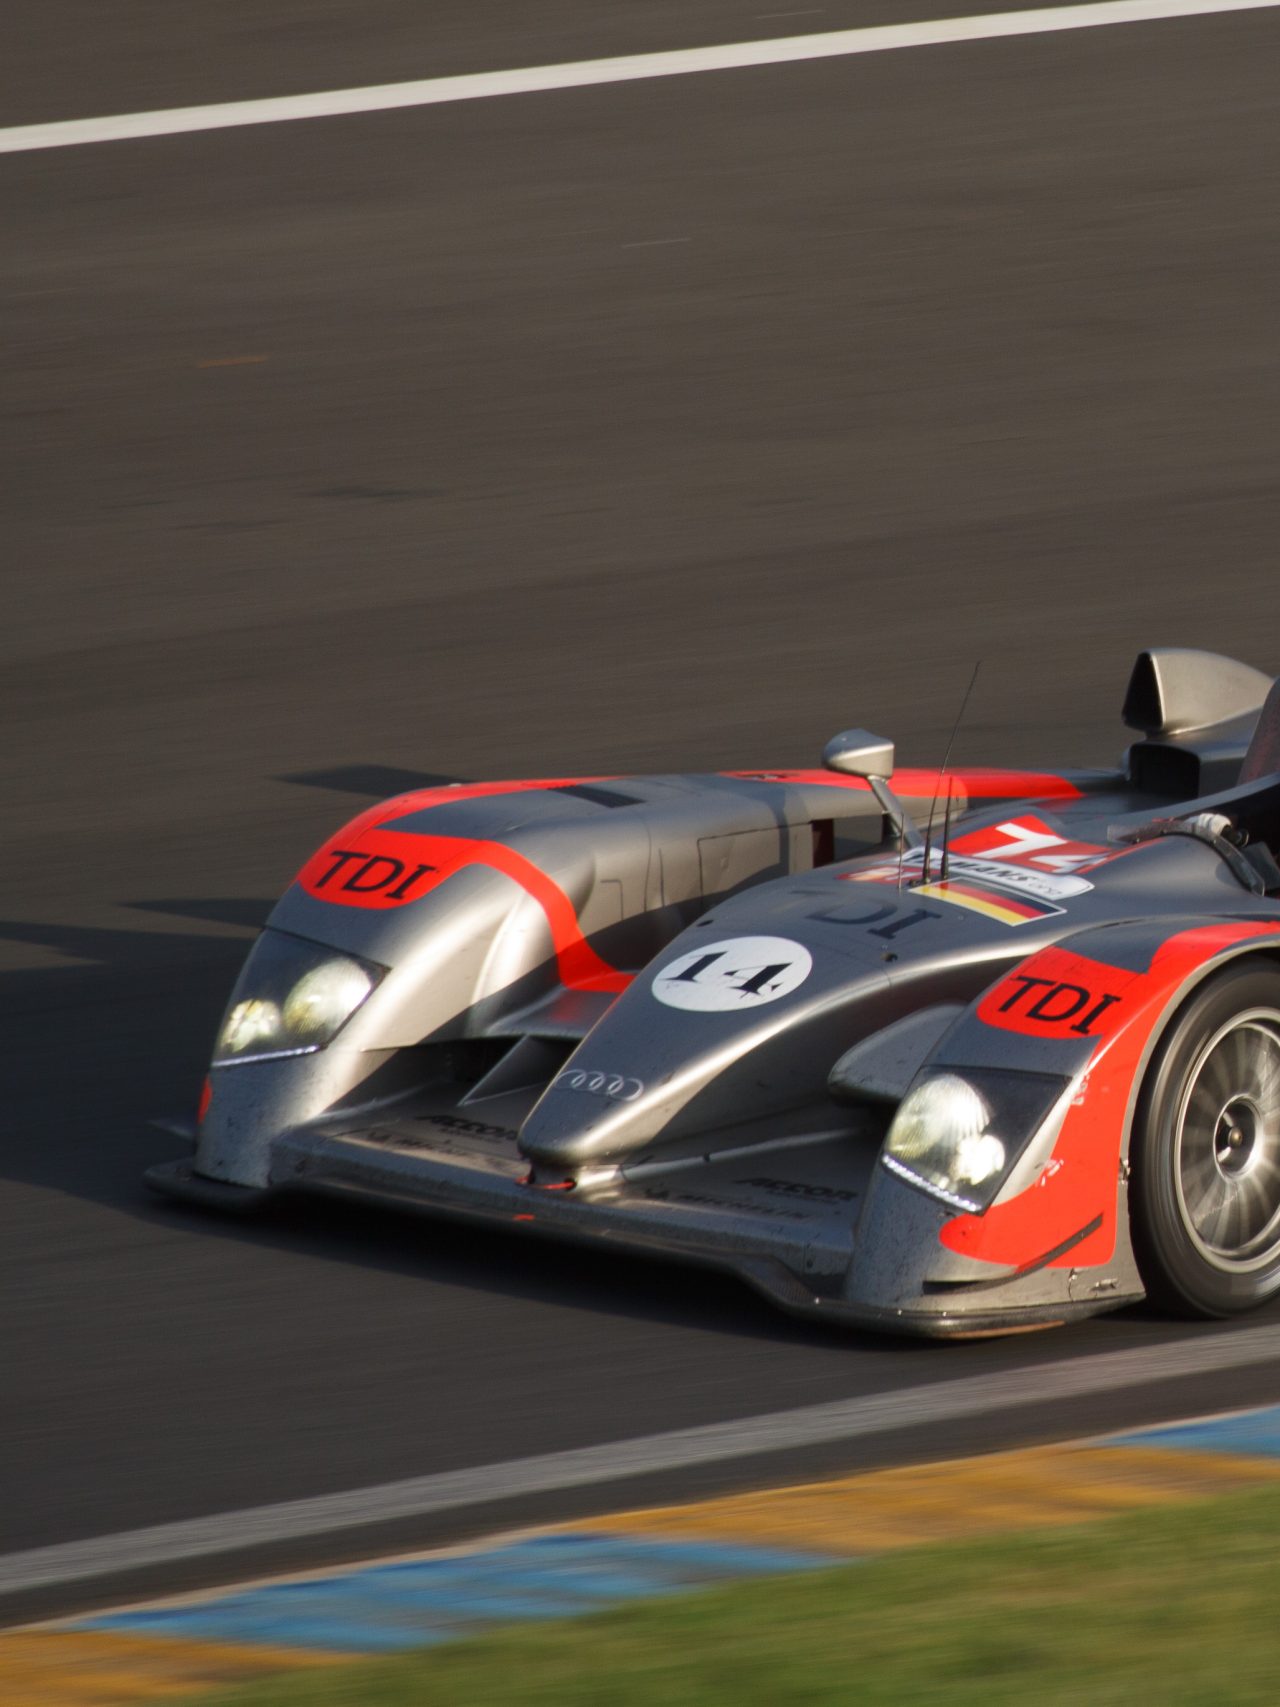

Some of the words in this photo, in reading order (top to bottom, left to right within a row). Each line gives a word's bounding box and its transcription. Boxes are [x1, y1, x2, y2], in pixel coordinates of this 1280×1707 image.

[314, 850, 437, 899] TDI
[789, 888, 942, 939] DI
[657, 951, 793, 999] 14
[998, 975, 1122, 1034] TDI
